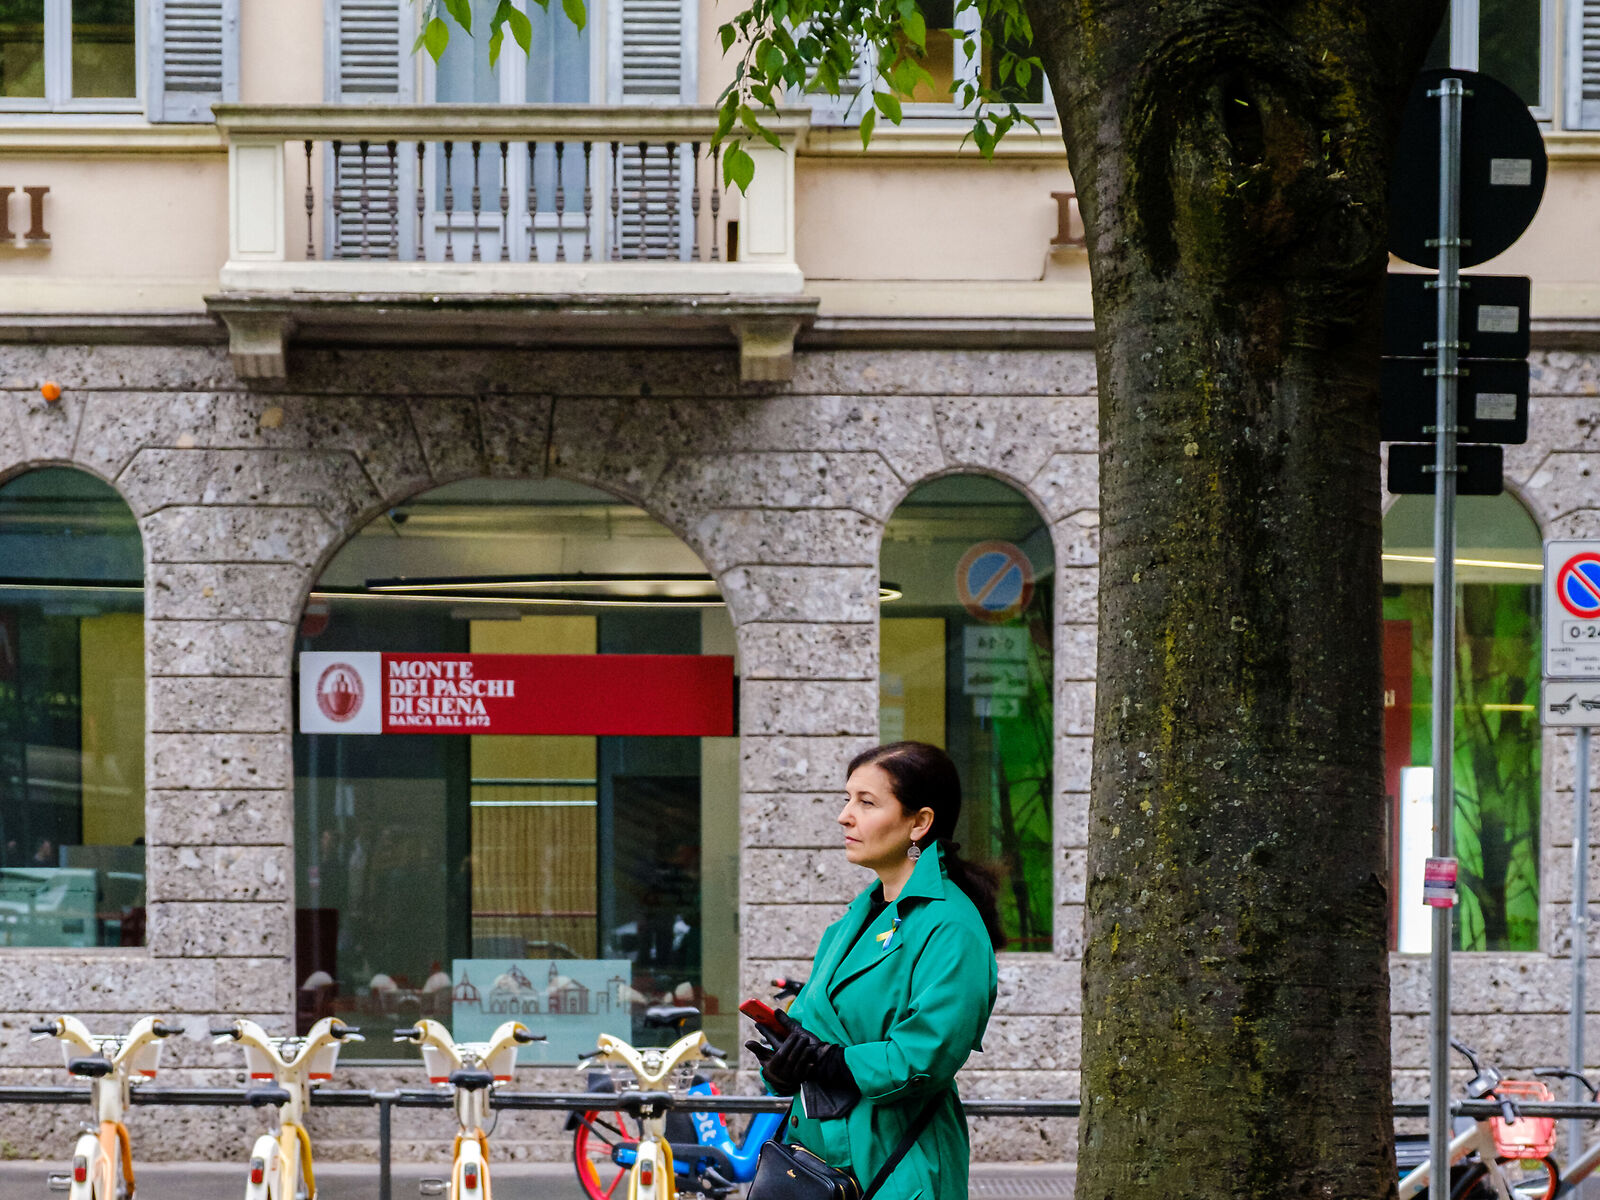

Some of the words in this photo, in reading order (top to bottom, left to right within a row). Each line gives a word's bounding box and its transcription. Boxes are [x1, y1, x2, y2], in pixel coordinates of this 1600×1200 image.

[1570, 625, 1600, 638] 0-2
[389, 660, 473, 679] MONTE
[389, 679, 428, 697] DEI
[433, 679, 515, 697] PASCHI
[390, 697, 413, 715] DI
[416, 697, 487, 715] SIENA
[388, 715, 432, 726] BANCA
[435, 715, 462, 727] DAL
[465, 715, 490, 727] 1472
